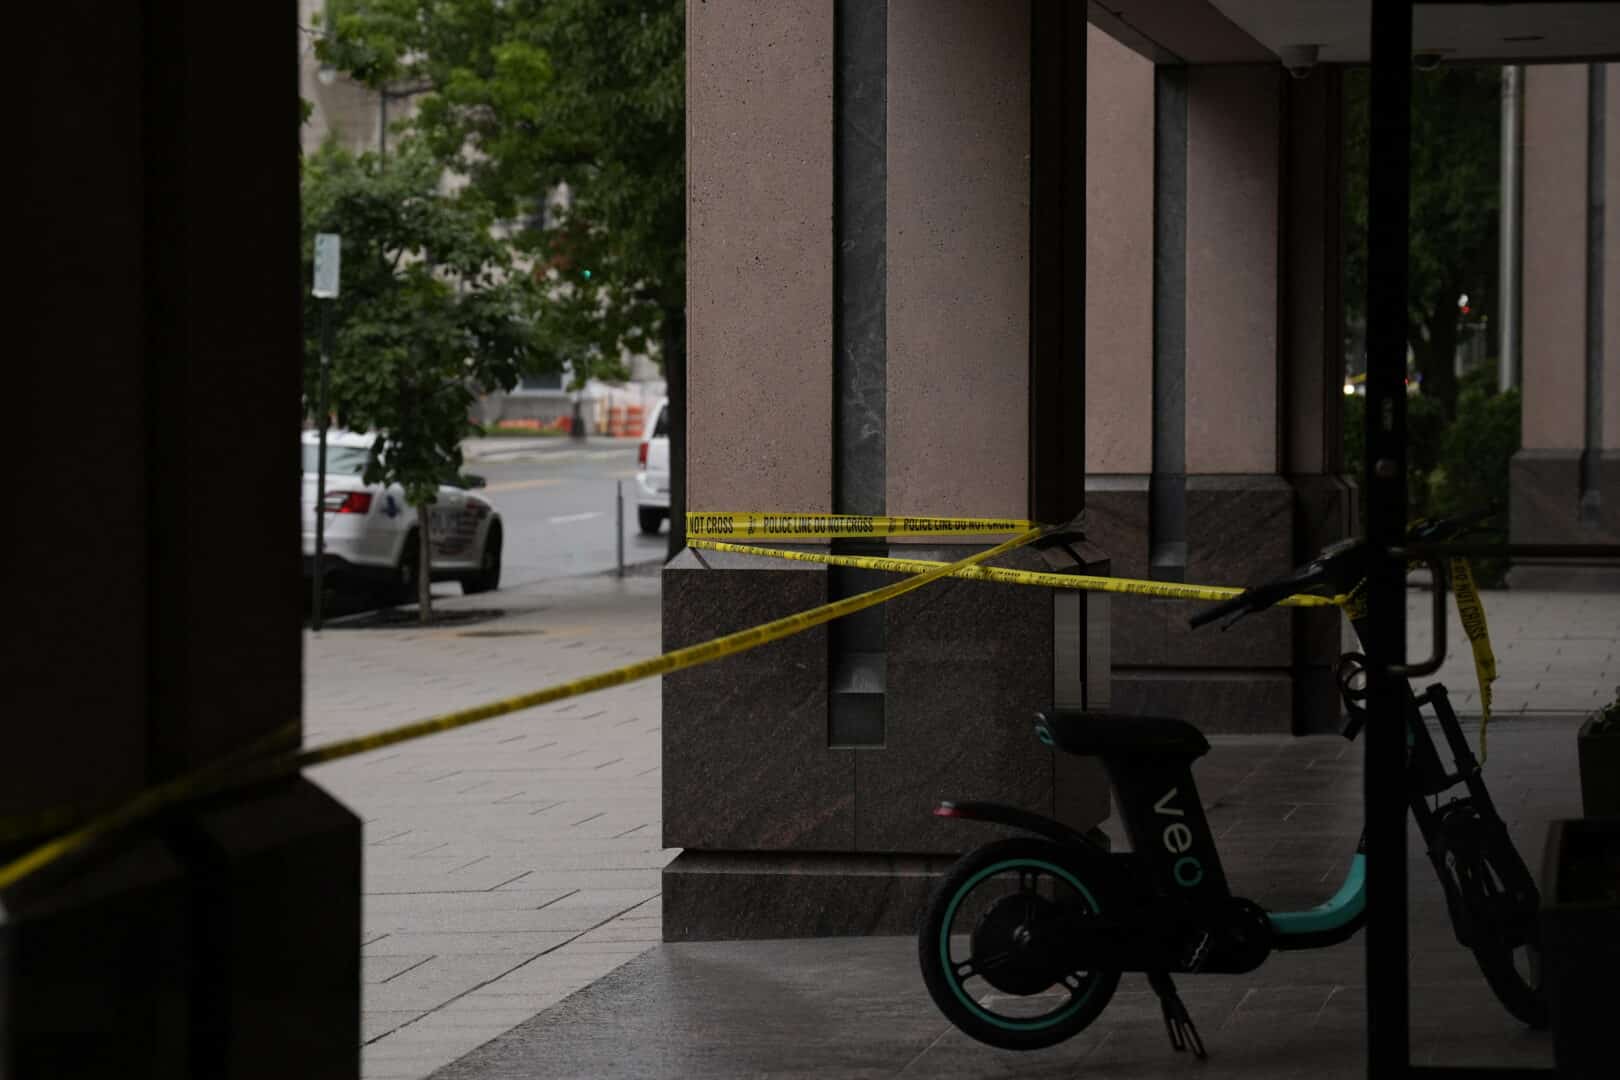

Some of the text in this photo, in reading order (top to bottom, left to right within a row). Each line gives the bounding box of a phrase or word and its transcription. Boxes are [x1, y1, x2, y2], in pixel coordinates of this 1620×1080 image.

[706, 516, 734, 534] CROSS
[763, 516, 793, 534] POLICE
[794, 516, 812, 534] LINE
[814, 516, 827, 534] DO
[829, 516, 845, 533] NOT
[846, 516, 874, 533] CROSS
[903, 518, 932, 532] POLICE
[934, 519, 953, 531] LINE
[955, 520, 966, 530] DO
[1460, 605, 1486, 640] CROSS
[1153, 787, 1204, 887] veo
